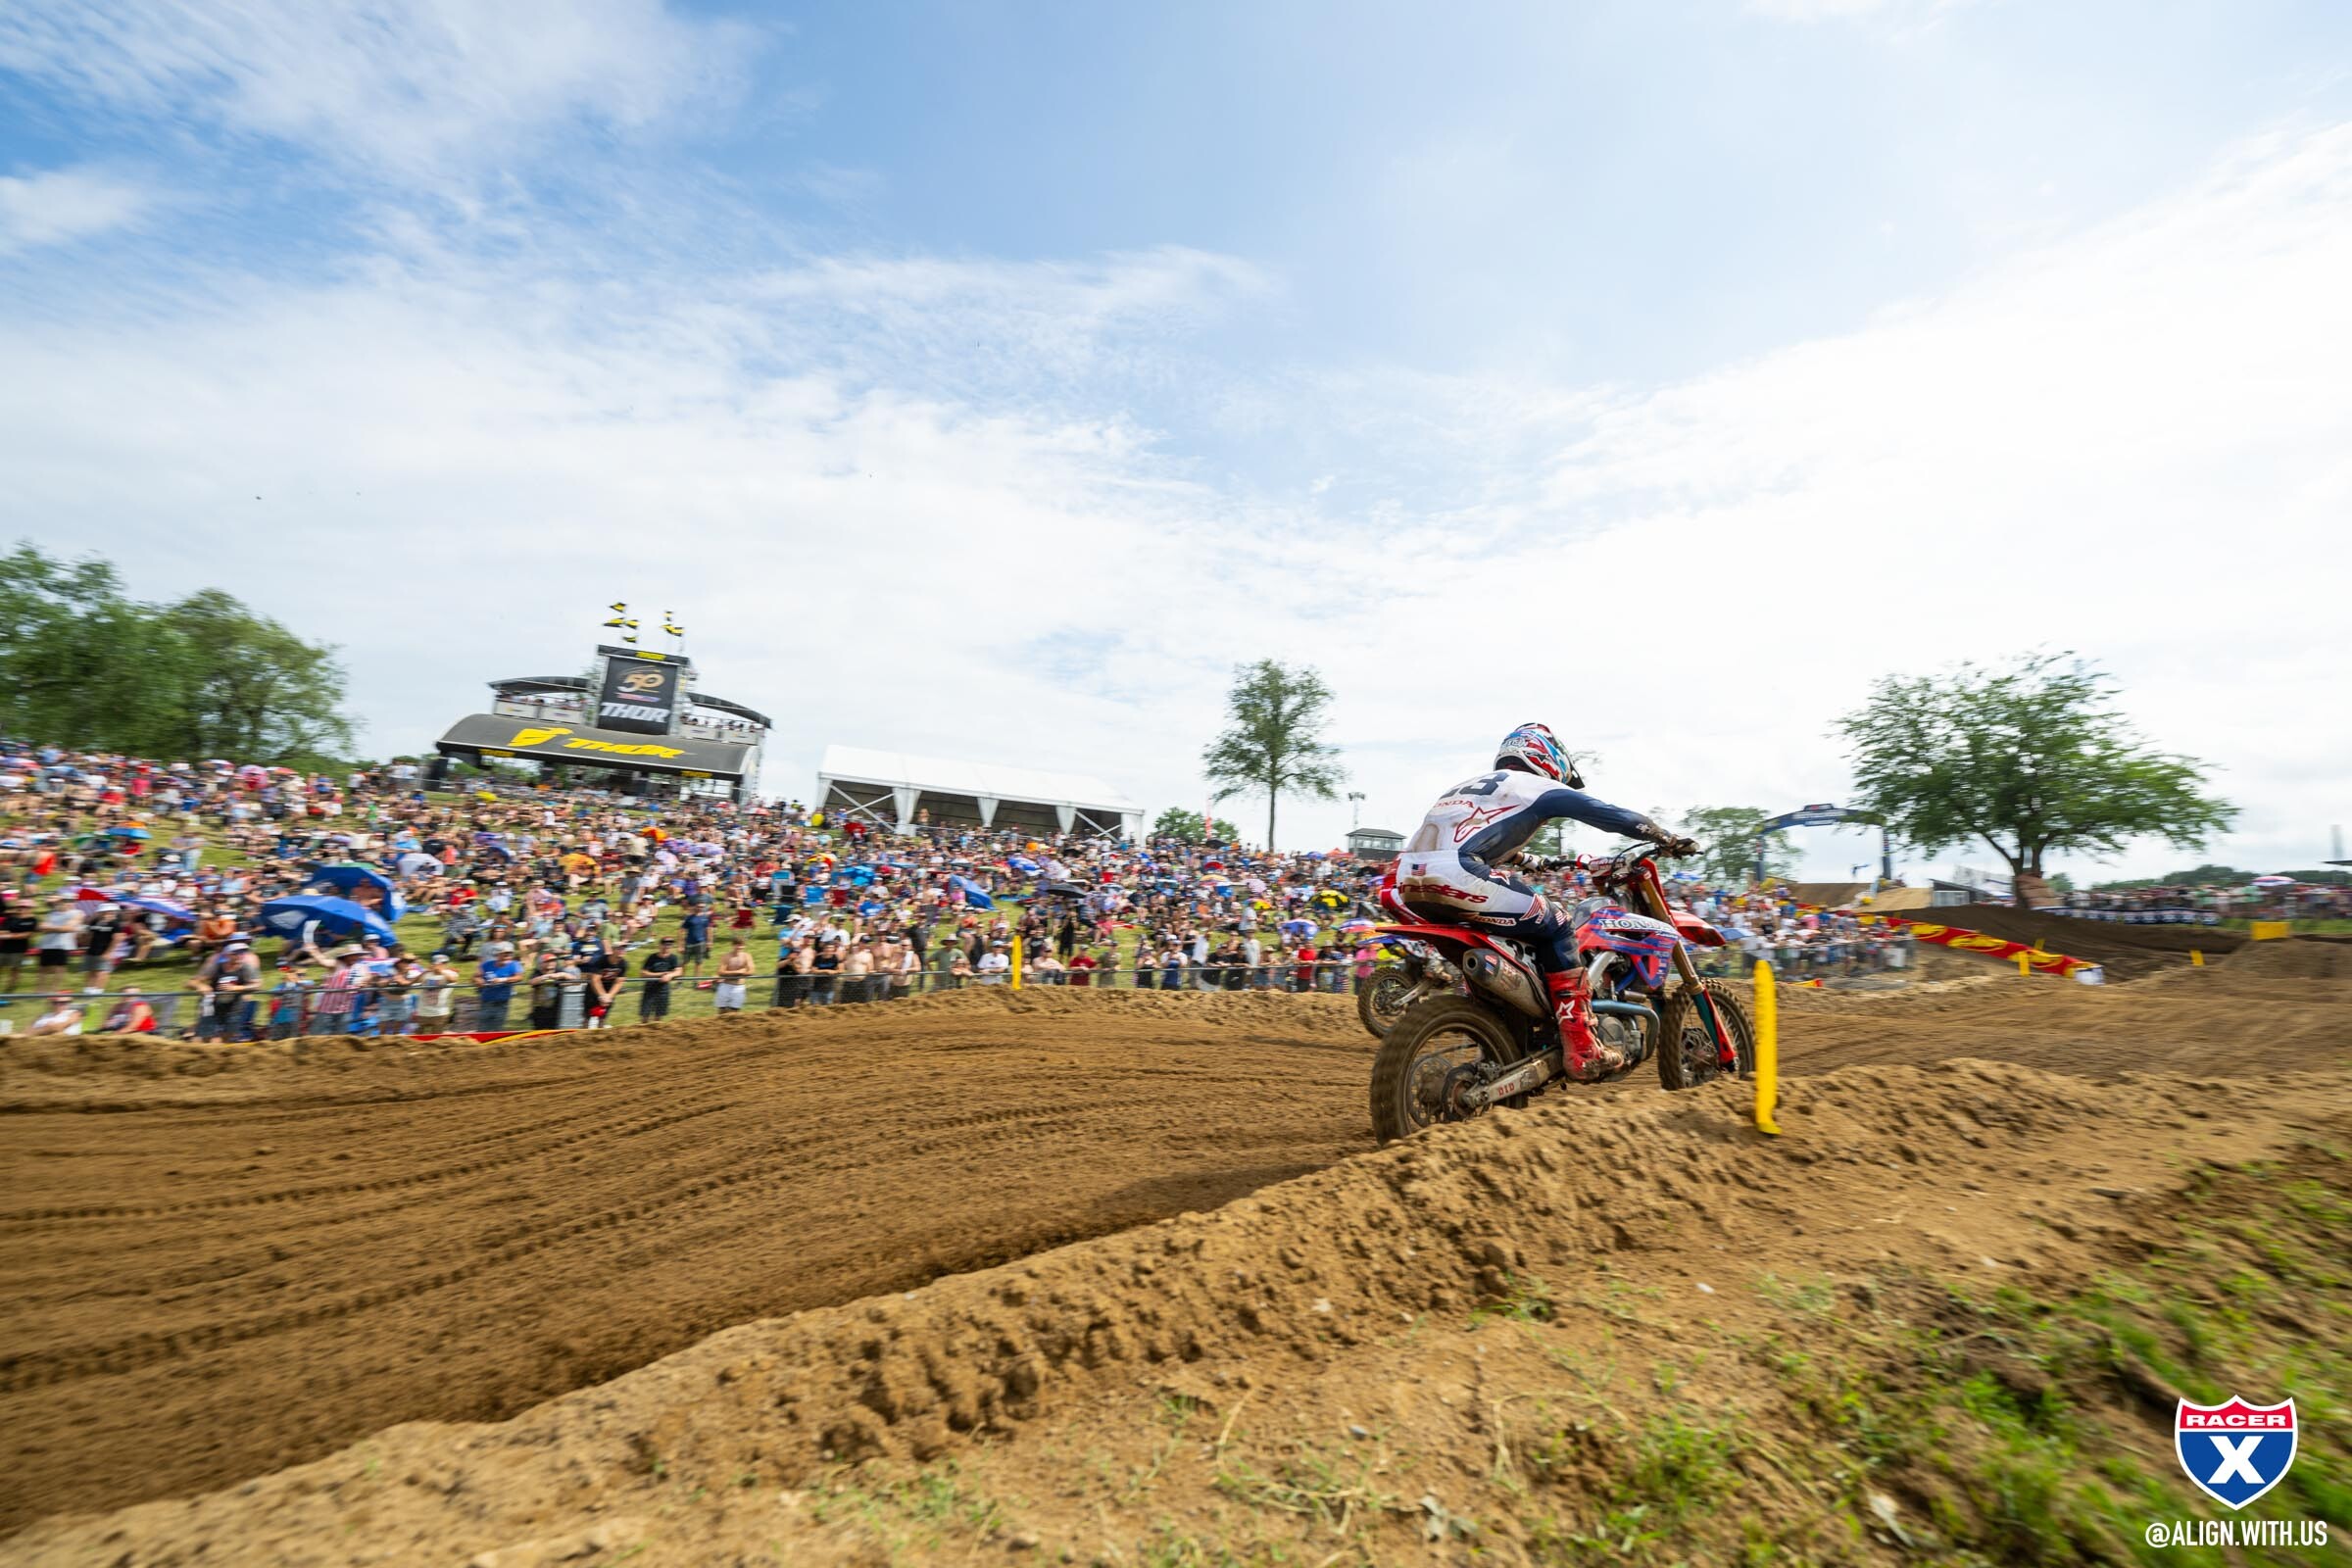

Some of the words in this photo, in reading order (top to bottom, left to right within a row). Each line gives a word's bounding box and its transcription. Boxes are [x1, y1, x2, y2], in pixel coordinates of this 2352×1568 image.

[599, 702, 670, 723] THOR
[564, 738, 684, 760] THOR
[1474, 915, 1515, 926] HONDA
